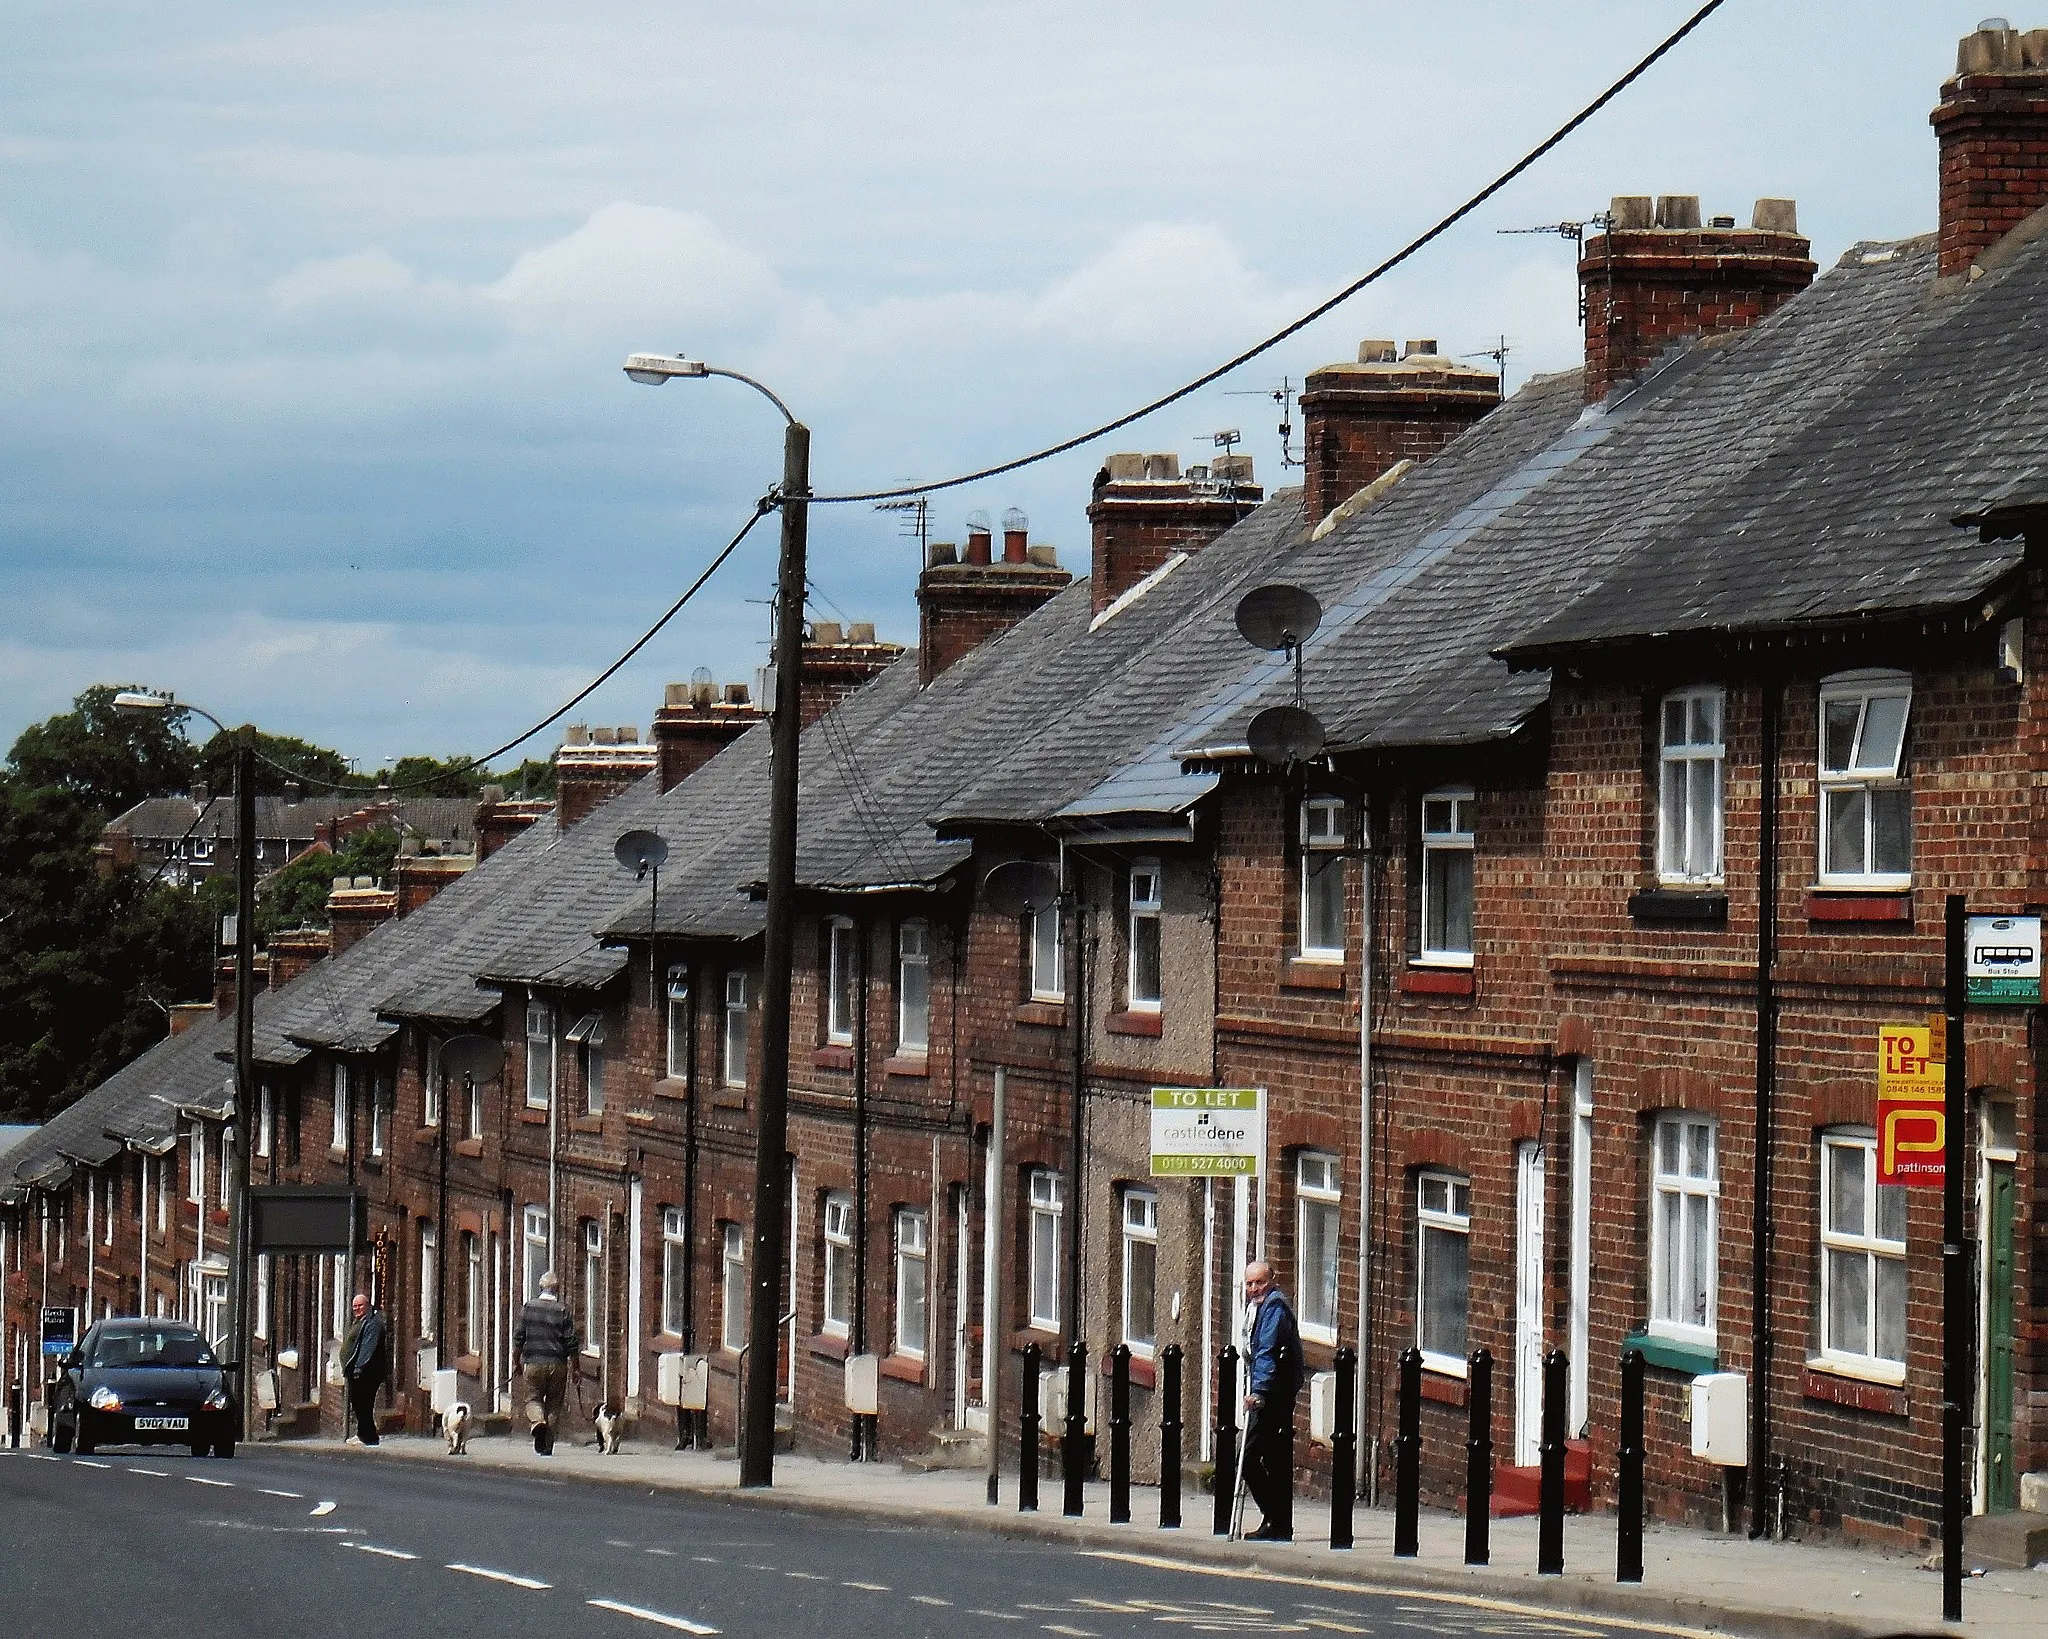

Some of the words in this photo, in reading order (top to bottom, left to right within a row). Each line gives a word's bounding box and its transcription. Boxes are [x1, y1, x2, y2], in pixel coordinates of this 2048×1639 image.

[1883, 1037, 1915, 1054] TO
[1887, 1057, 1929, 1074] LET
[1170, 1092, 1196, 1106] TO
[1205, 1093, 1240, 1106] LET
[1164, 1126, 1245, 1140] castledene
[1162, 1158, 1188, 1168] 0191
[1192, 1159, 1213, 1169] 527
[1216, 1159, 1246, 1170] 4000
[1898, 1163, 1945, 1174] pattinson
